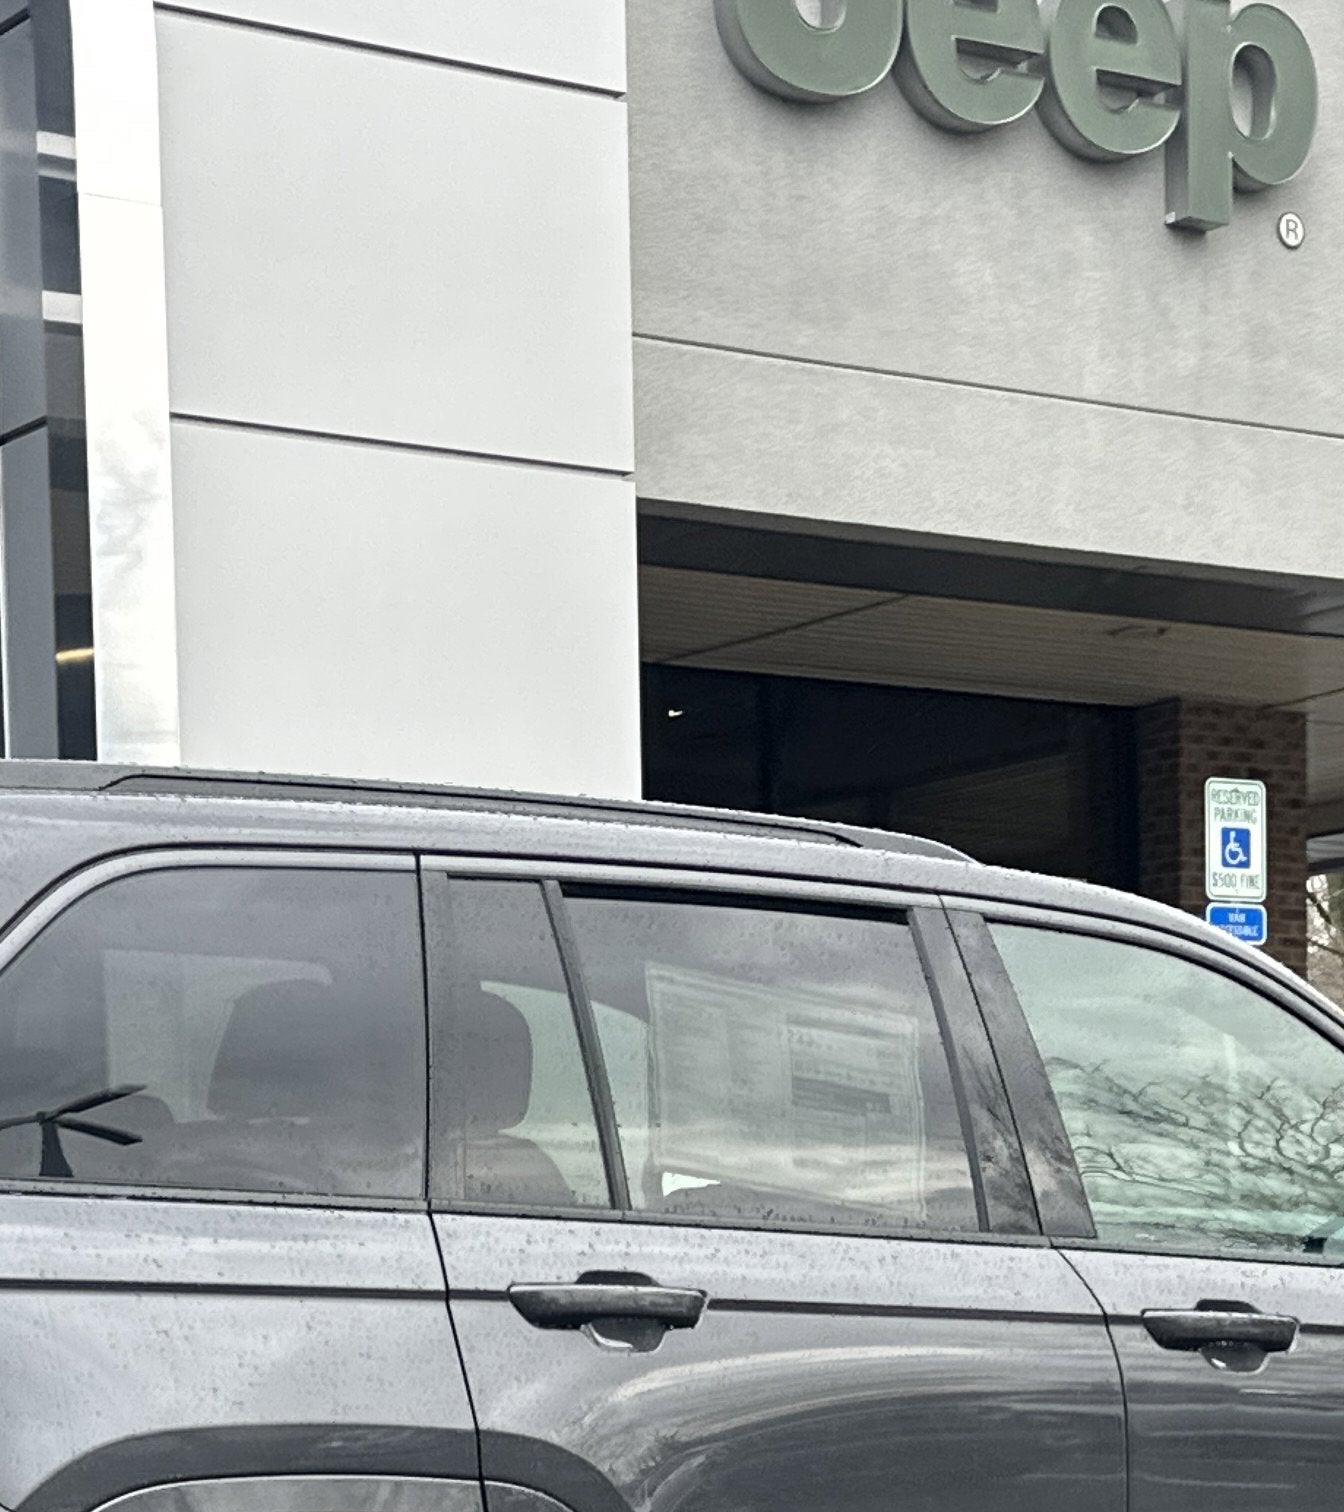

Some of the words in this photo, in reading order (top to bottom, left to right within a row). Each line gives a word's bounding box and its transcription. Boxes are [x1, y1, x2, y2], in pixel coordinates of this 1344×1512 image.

[1211, 788, 1260, 806] RESERVED
[1214, 807, 1257, 824] PARKING
[1240, 873, 1260, 889] FINE
